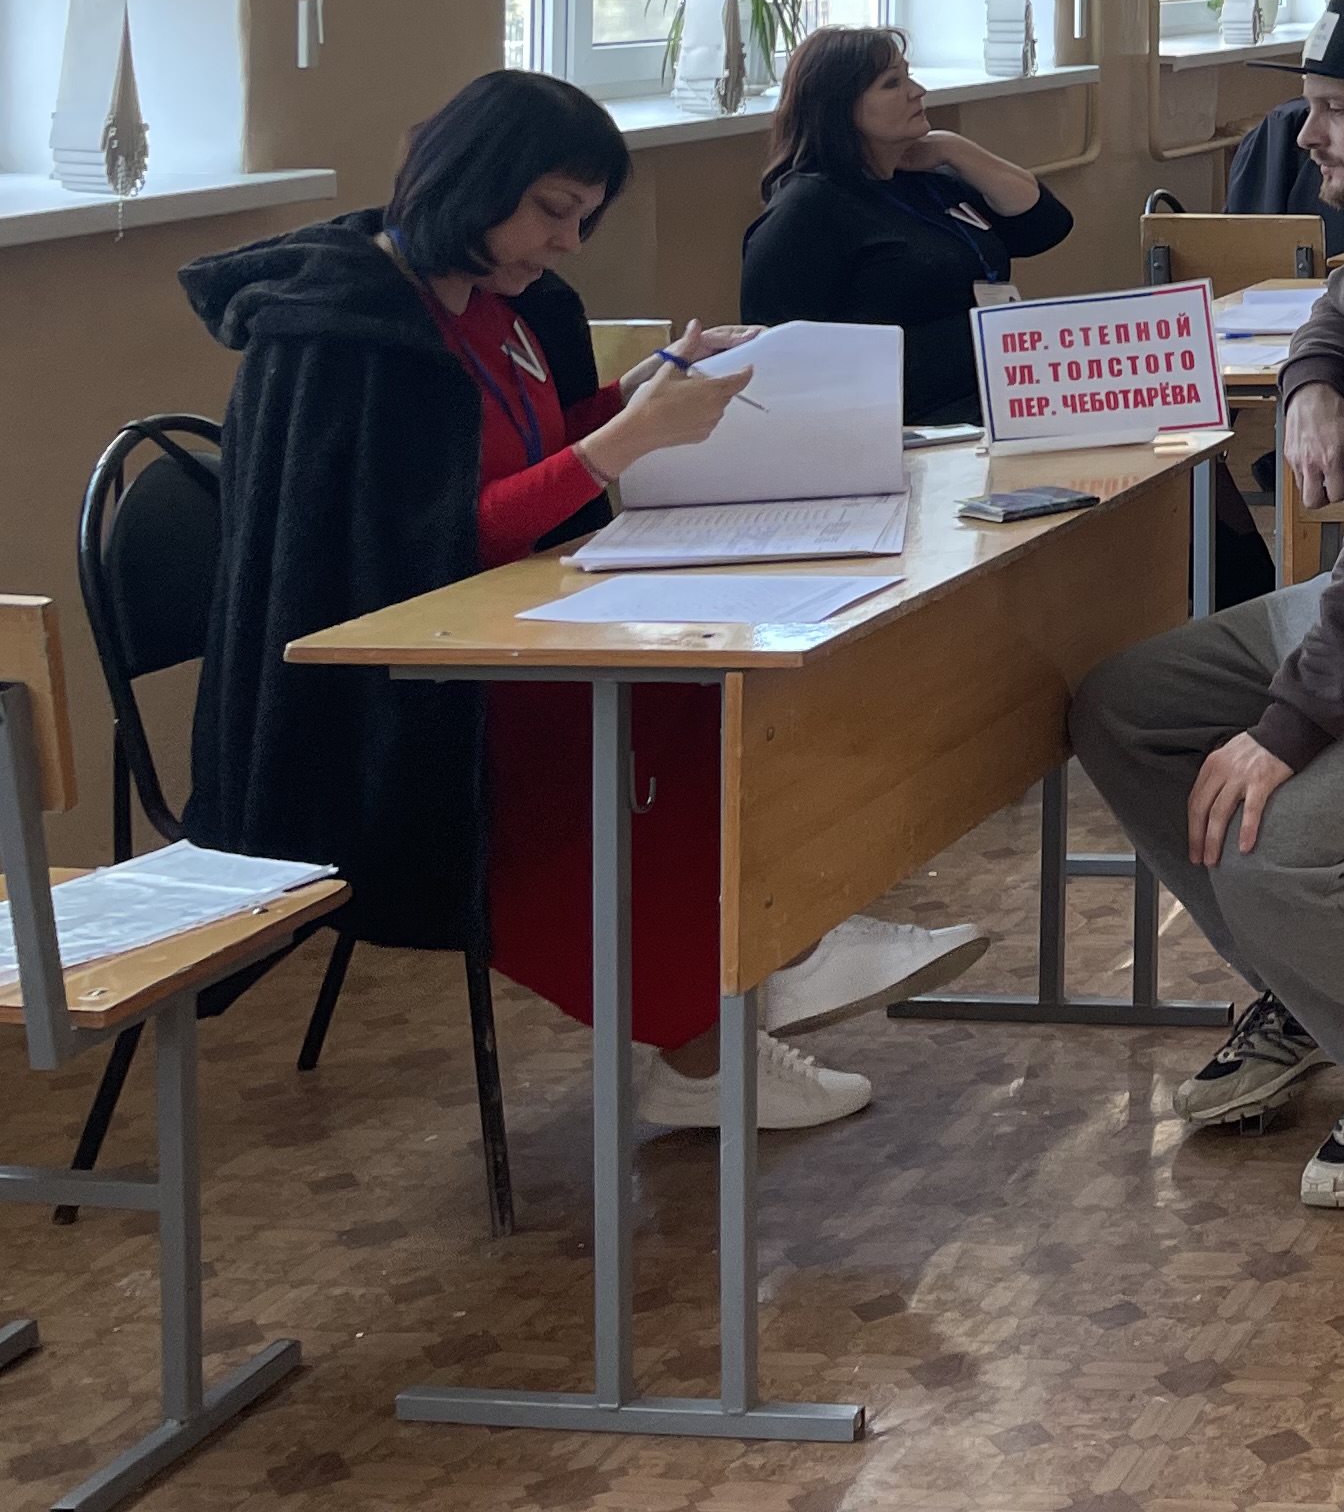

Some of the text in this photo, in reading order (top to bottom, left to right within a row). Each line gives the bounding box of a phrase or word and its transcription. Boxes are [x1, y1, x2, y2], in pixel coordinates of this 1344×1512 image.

[1001, 312, 1192, 353] ПЕР. СТЕПНОЙ
[1004, 349, 1196, 386] УЛ. ТОЛСТОГО
[1009, 381, 1201, 418] ПЕР. ЧЕБОТАРЁВА
